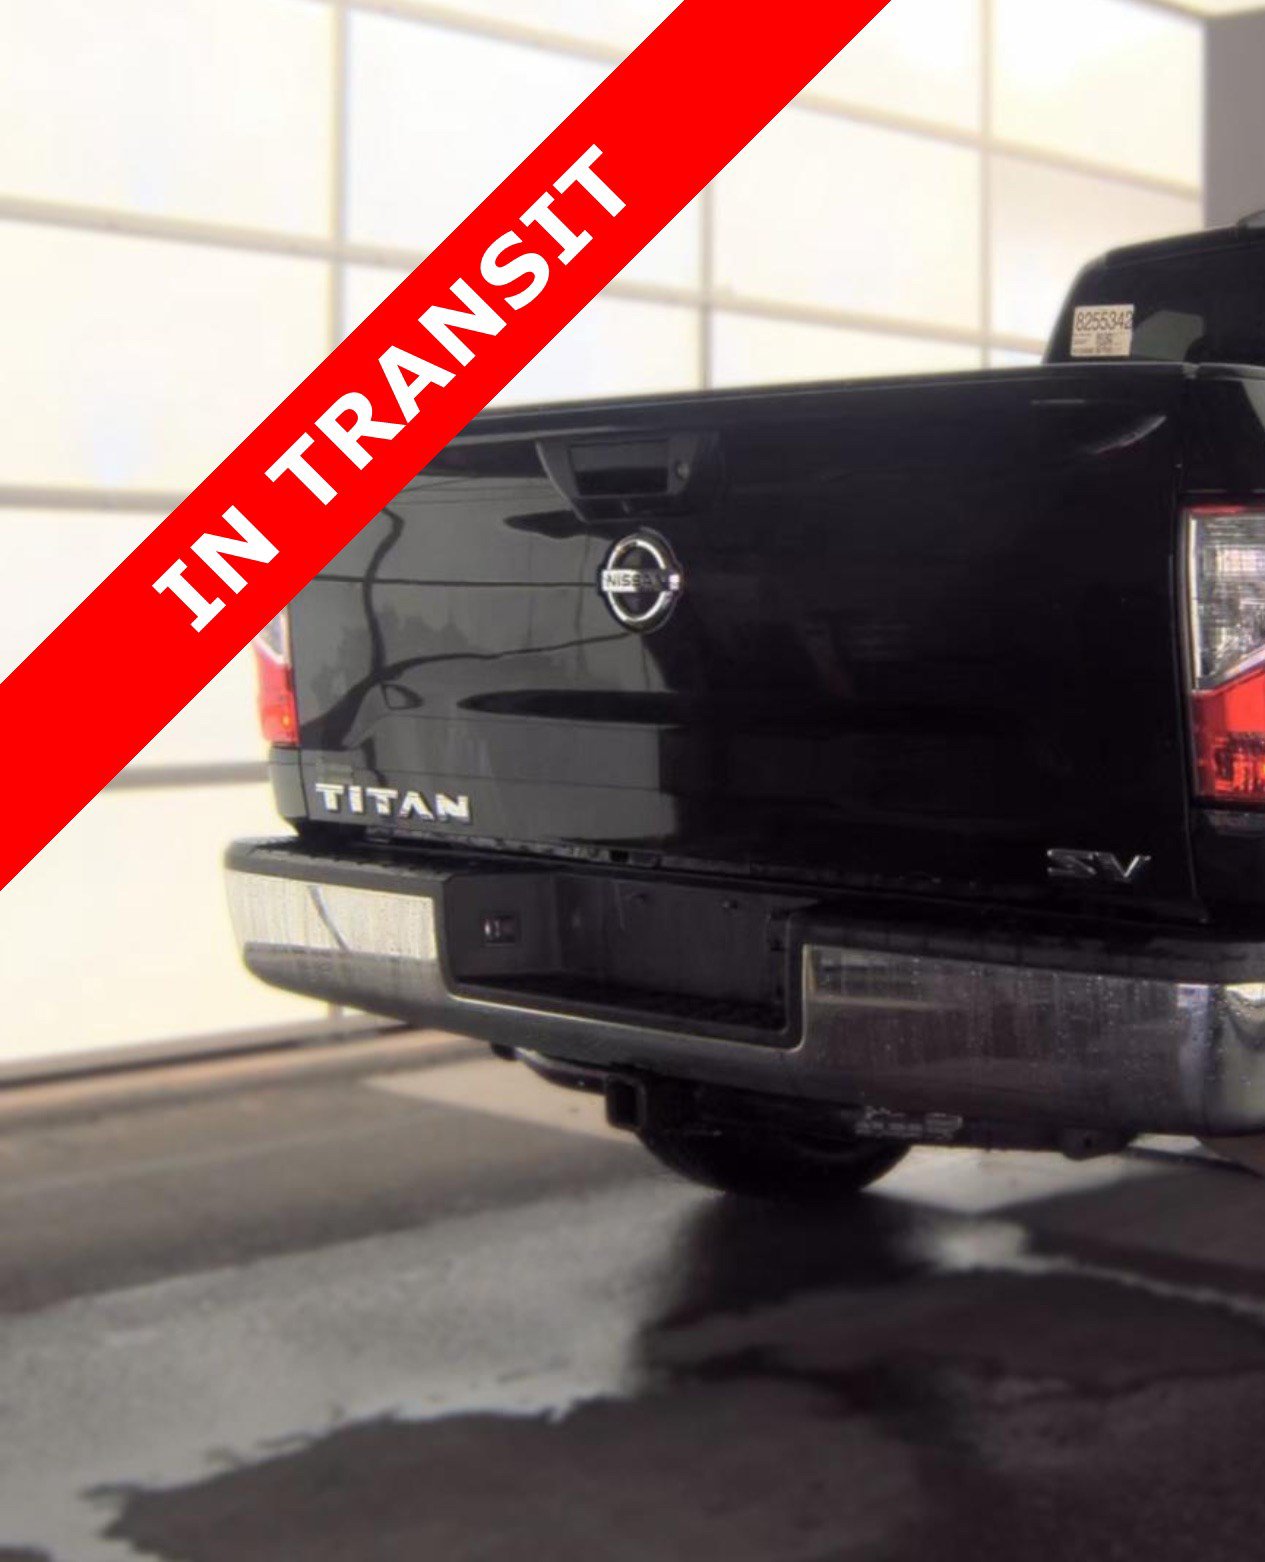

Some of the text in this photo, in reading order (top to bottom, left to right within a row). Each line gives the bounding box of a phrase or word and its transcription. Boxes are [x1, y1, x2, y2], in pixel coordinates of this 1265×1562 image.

[1076, 310, 1133, 332] 8255342
[315, 783, 472, 823] TITAN
[1046, 848, 1151, 880] SV
